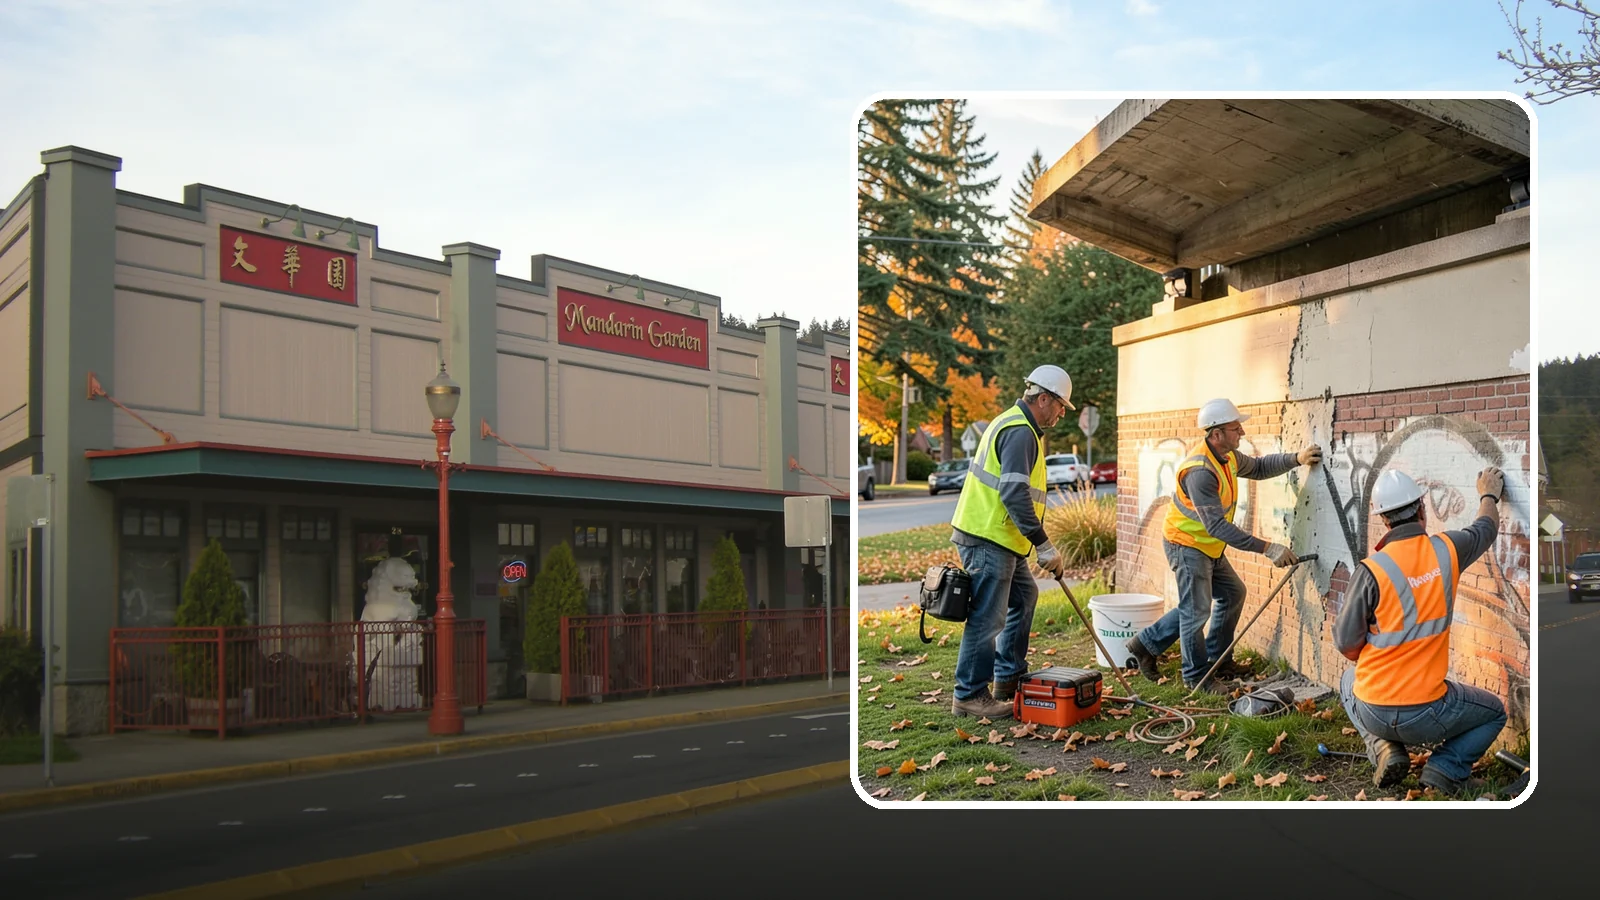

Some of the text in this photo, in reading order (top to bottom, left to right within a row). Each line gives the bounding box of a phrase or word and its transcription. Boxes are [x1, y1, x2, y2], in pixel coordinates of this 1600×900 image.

[231, 236, 346, 291] 文華園
[564, 302, 702, 352] Mandarin Garden
[503, 565, 527, 578] OPEN
